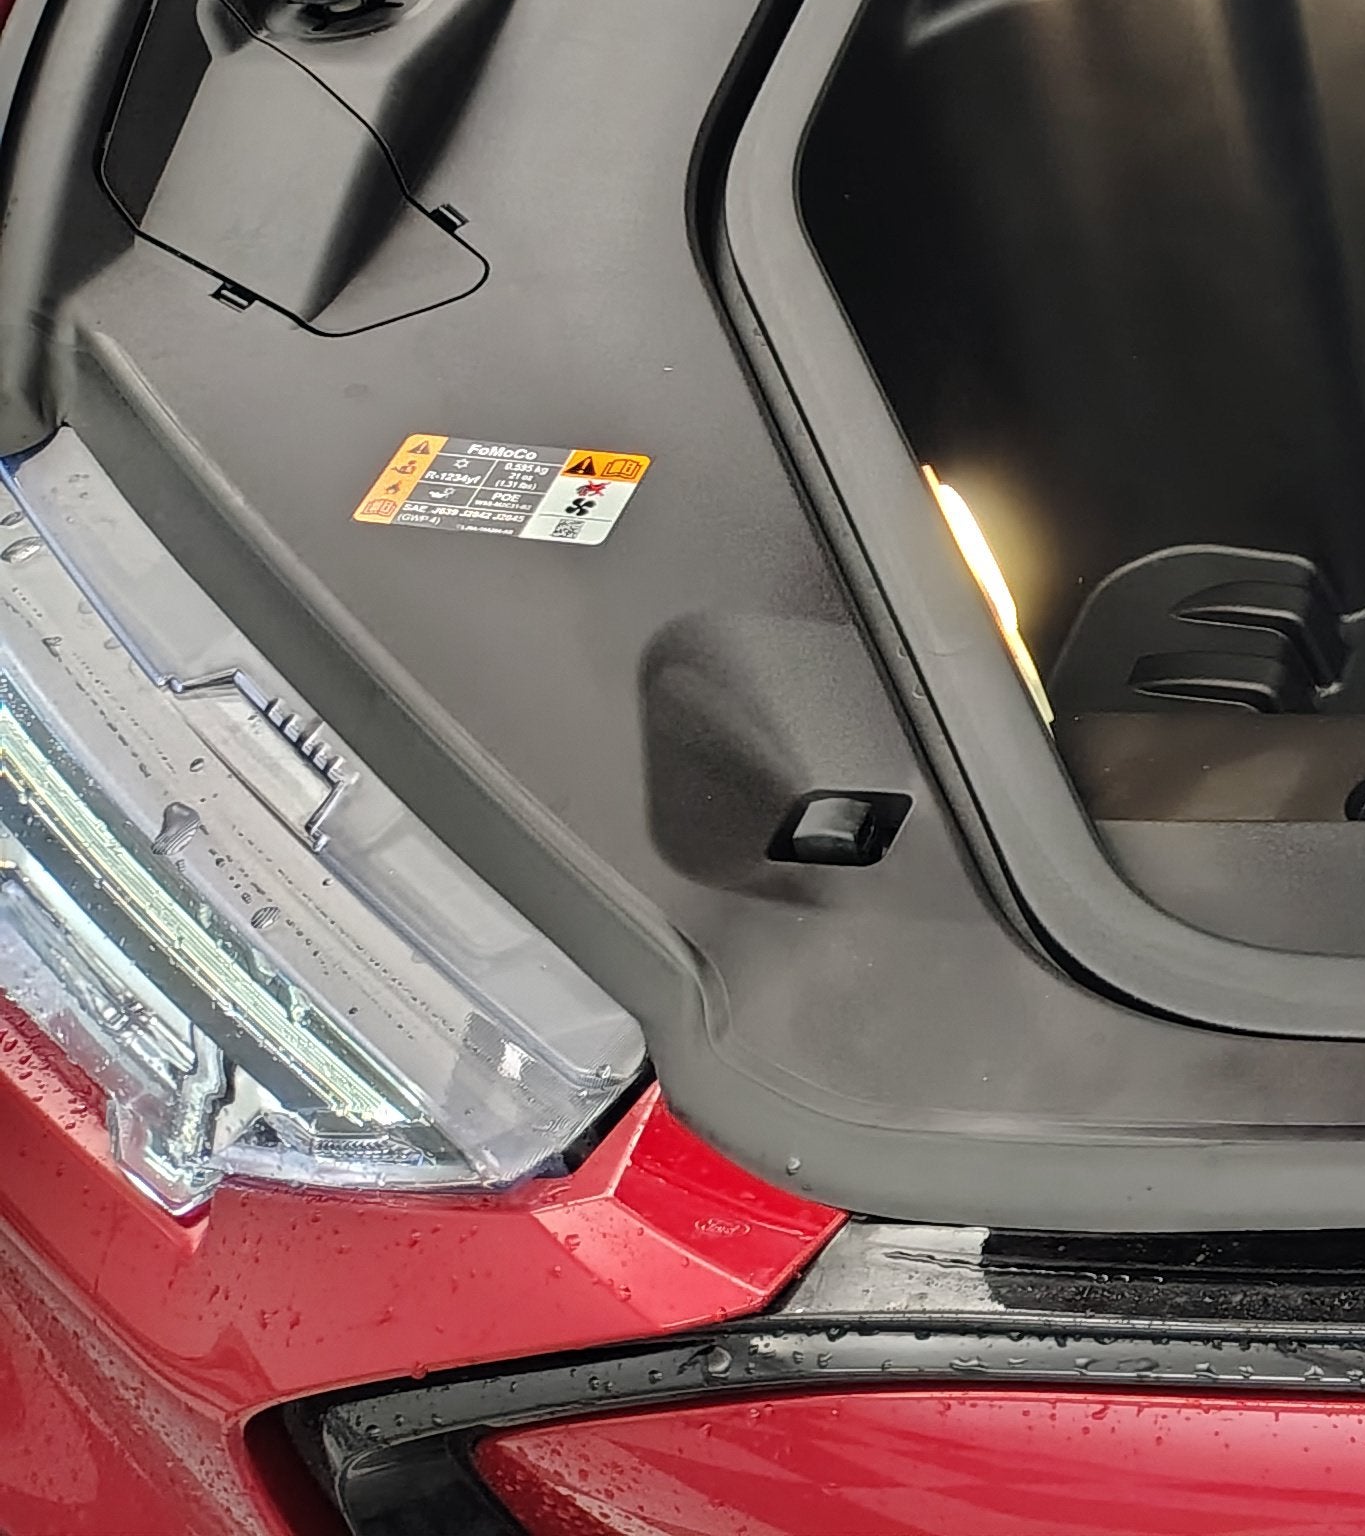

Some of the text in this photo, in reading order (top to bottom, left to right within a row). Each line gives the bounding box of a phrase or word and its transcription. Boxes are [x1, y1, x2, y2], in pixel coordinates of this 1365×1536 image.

[467, 443, 537, 460] FoMoCo
[534, 465, 550, 476] kg
[424, 470, 482, 485] R-1234yf
[491, 492, 522, 503] POE
[402, 503, 428, 513] SAE
